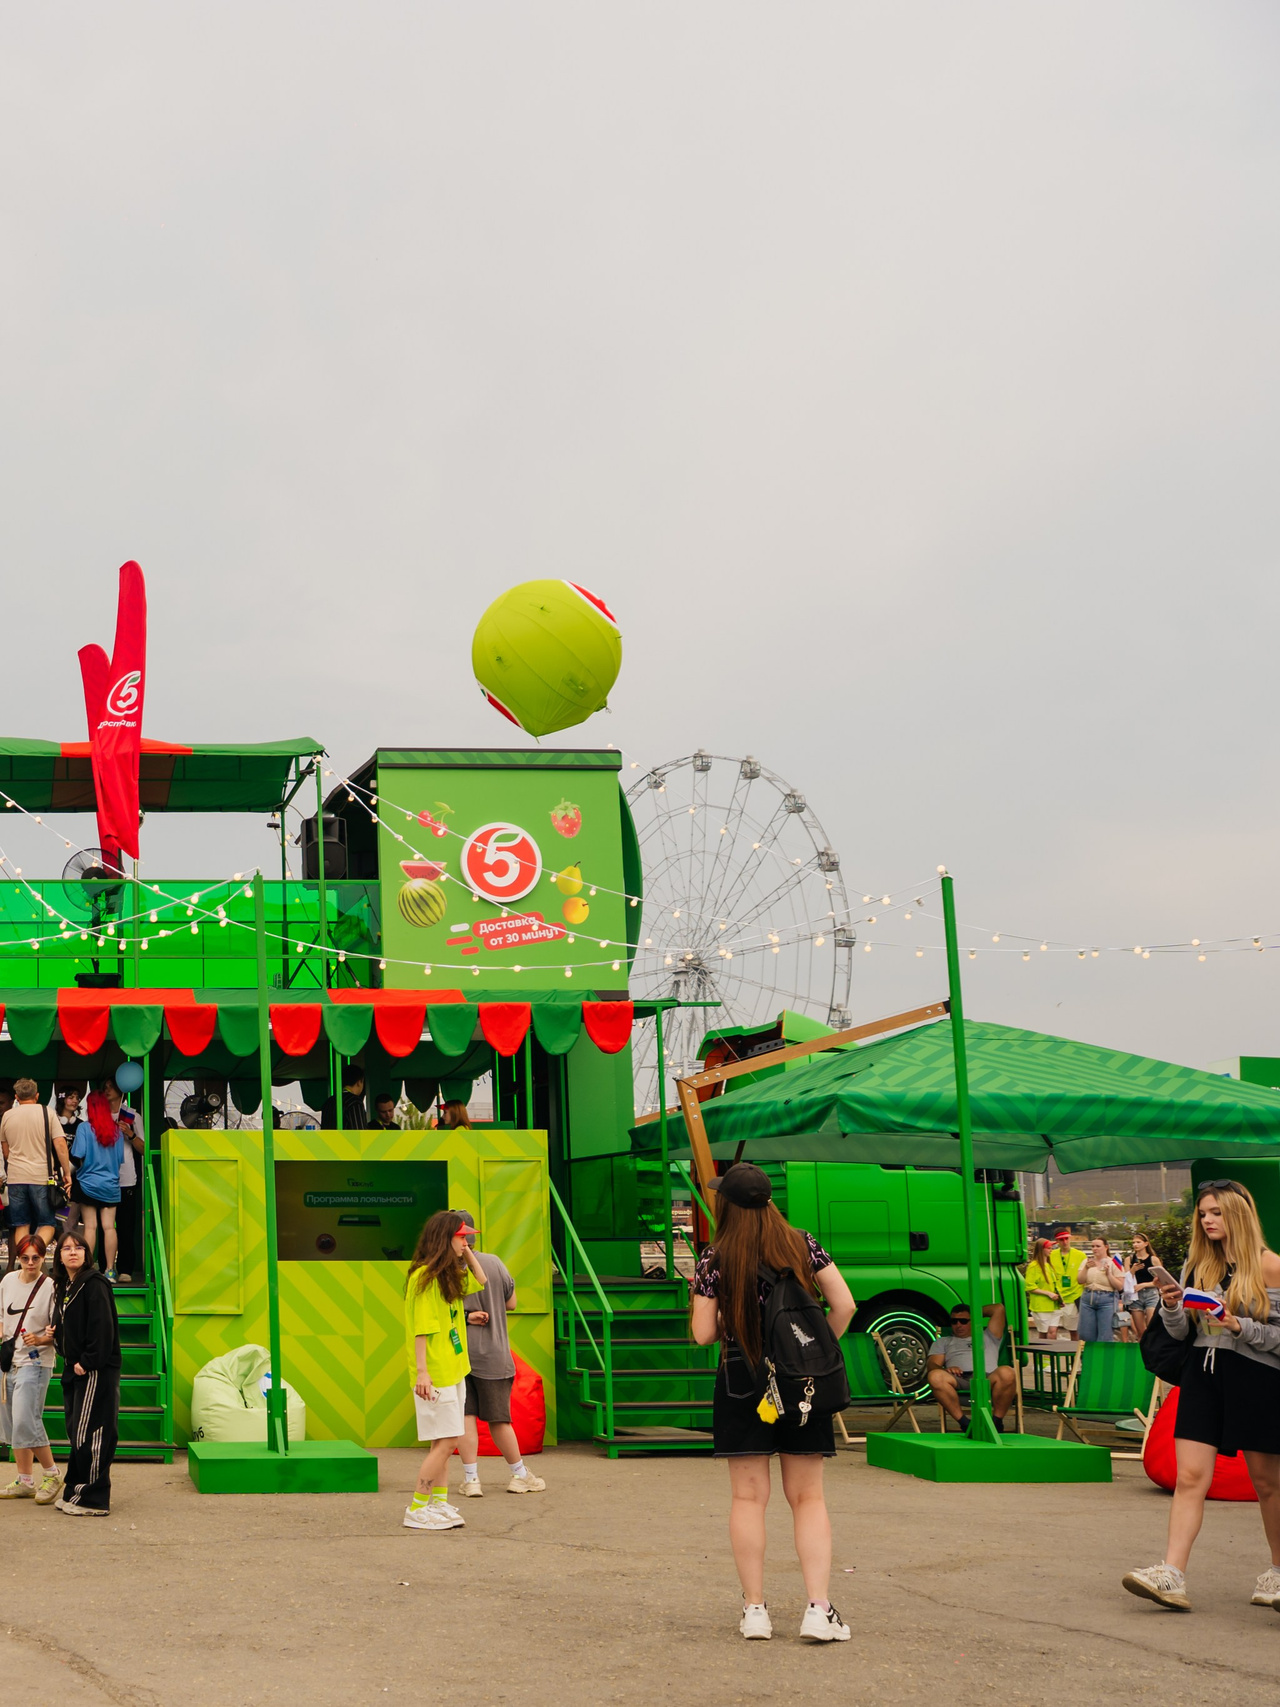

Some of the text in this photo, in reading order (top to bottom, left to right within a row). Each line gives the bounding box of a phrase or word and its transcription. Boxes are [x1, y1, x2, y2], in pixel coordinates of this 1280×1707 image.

[483, 829, 524, 887] 5
[479, 916, 536, 935] Доставка
[489, 928, 560, 946] от 30 минут
[306, 1194, 413, 1205] Программа лояльности
